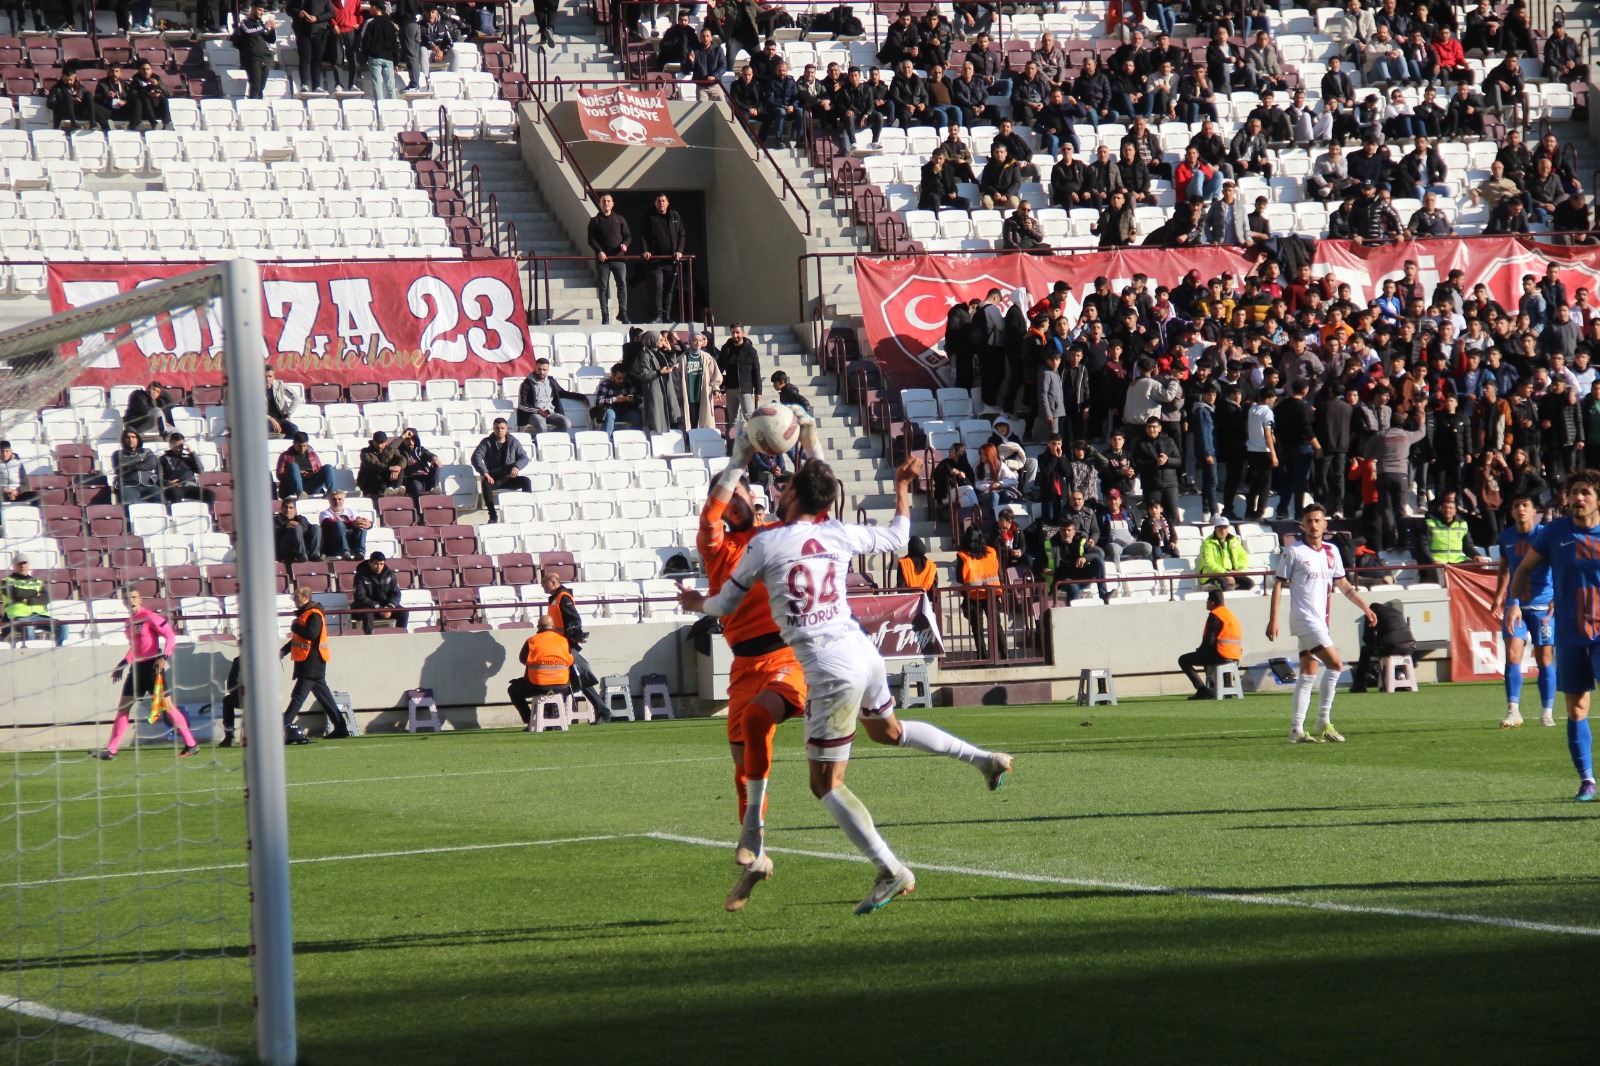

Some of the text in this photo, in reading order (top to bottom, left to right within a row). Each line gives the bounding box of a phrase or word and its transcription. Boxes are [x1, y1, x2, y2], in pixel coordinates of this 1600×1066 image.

[584, 104, 660, 122] YOK ENDİŞEYE
[626, 93, 664, 109] MAHAL
[62, 274, 525, 369] FOZA 23
[367, 333, 426, 370] love
[786, 559, 840, 616] 94
